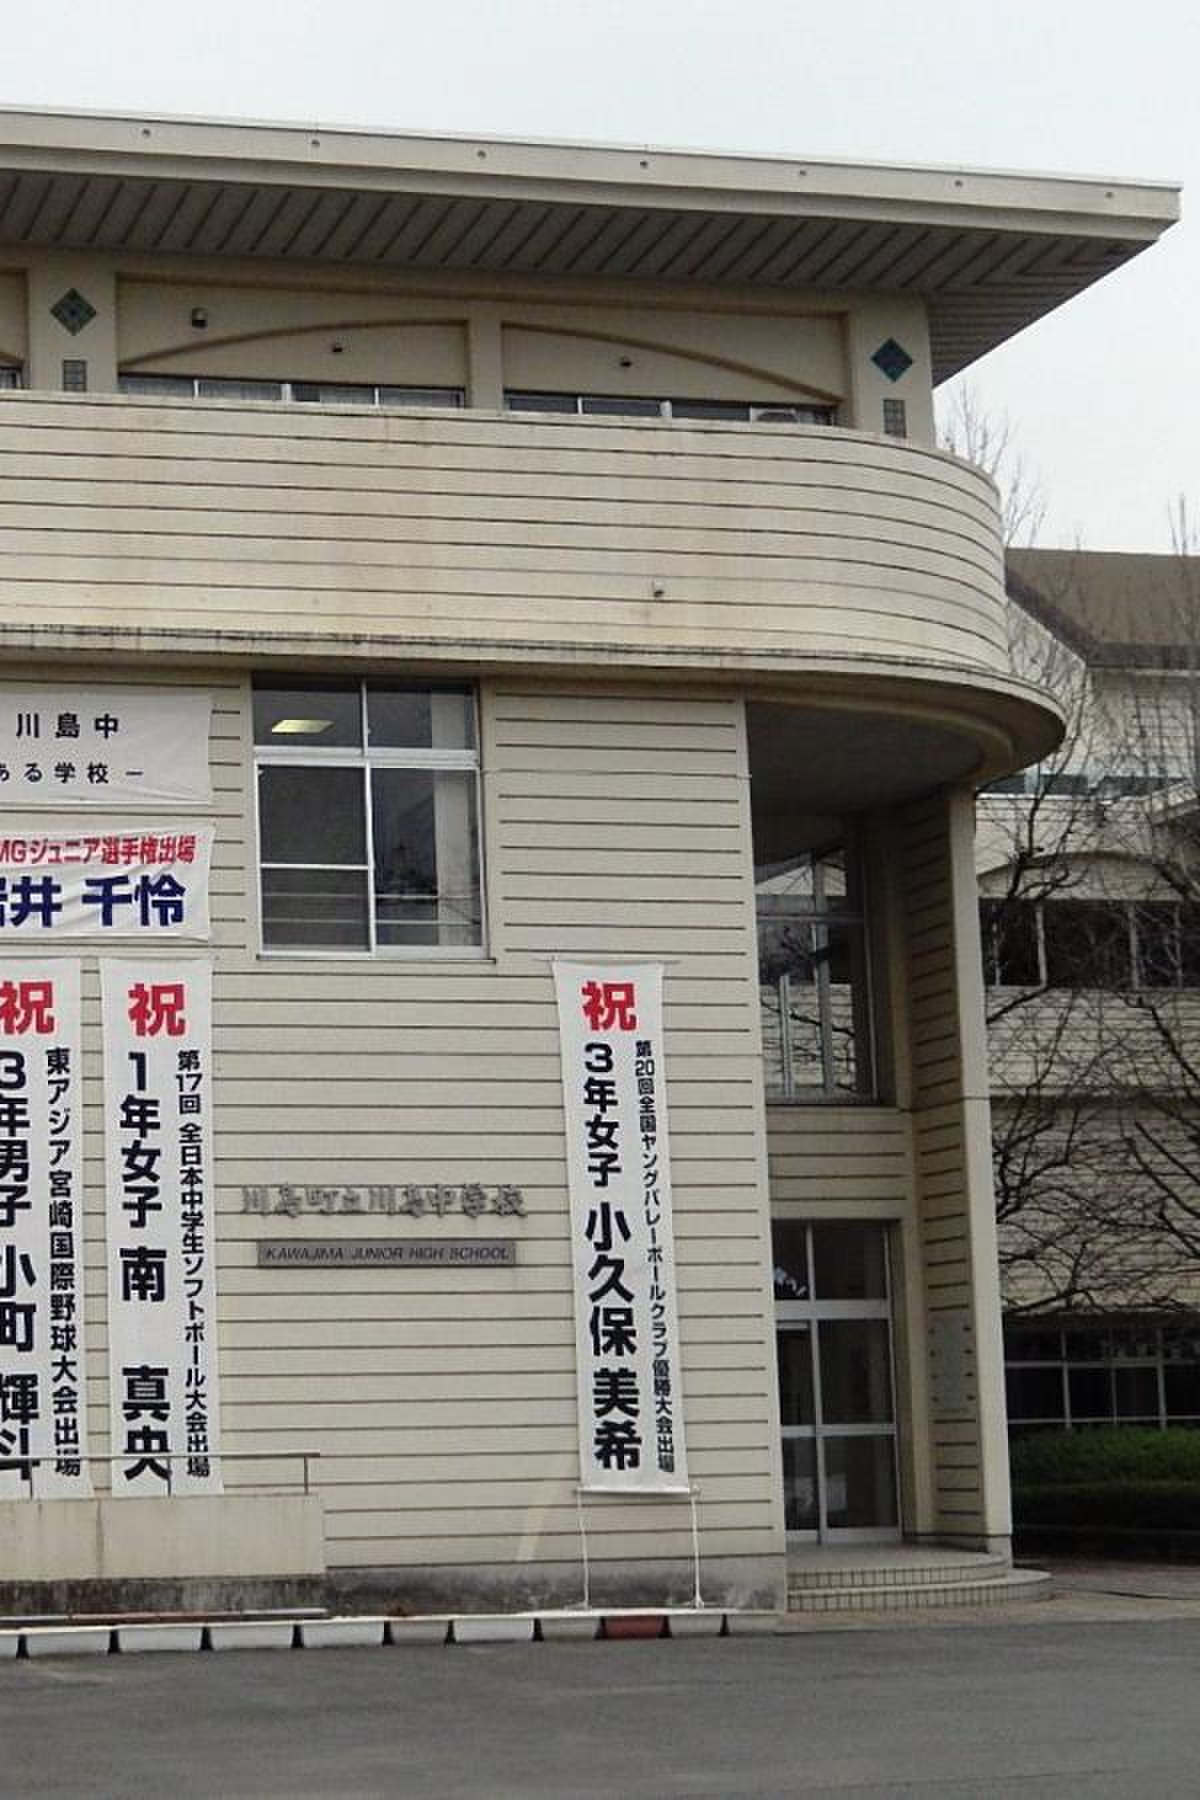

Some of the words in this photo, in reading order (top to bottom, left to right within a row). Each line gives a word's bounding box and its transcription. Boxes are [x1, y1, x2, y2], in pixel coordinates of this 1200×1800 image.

[81, 874, 187, 927] 千怜
[127, 983, 187, 1037] 祝
[580, 981, 638, 1032] 祝
[119, 1051, 163, 1229] 1年女子
[583, 1042, 622, 1188] 3年女子
[119, 1245, 167, 1303] 南
[351, 1246, 403, 1260] JUNIOR
[409, 1246, 444, 1260] HIGH
[449, 1246, 510, 1260] SCHOOL
[585, 1201, 638, 1357] 小久保
